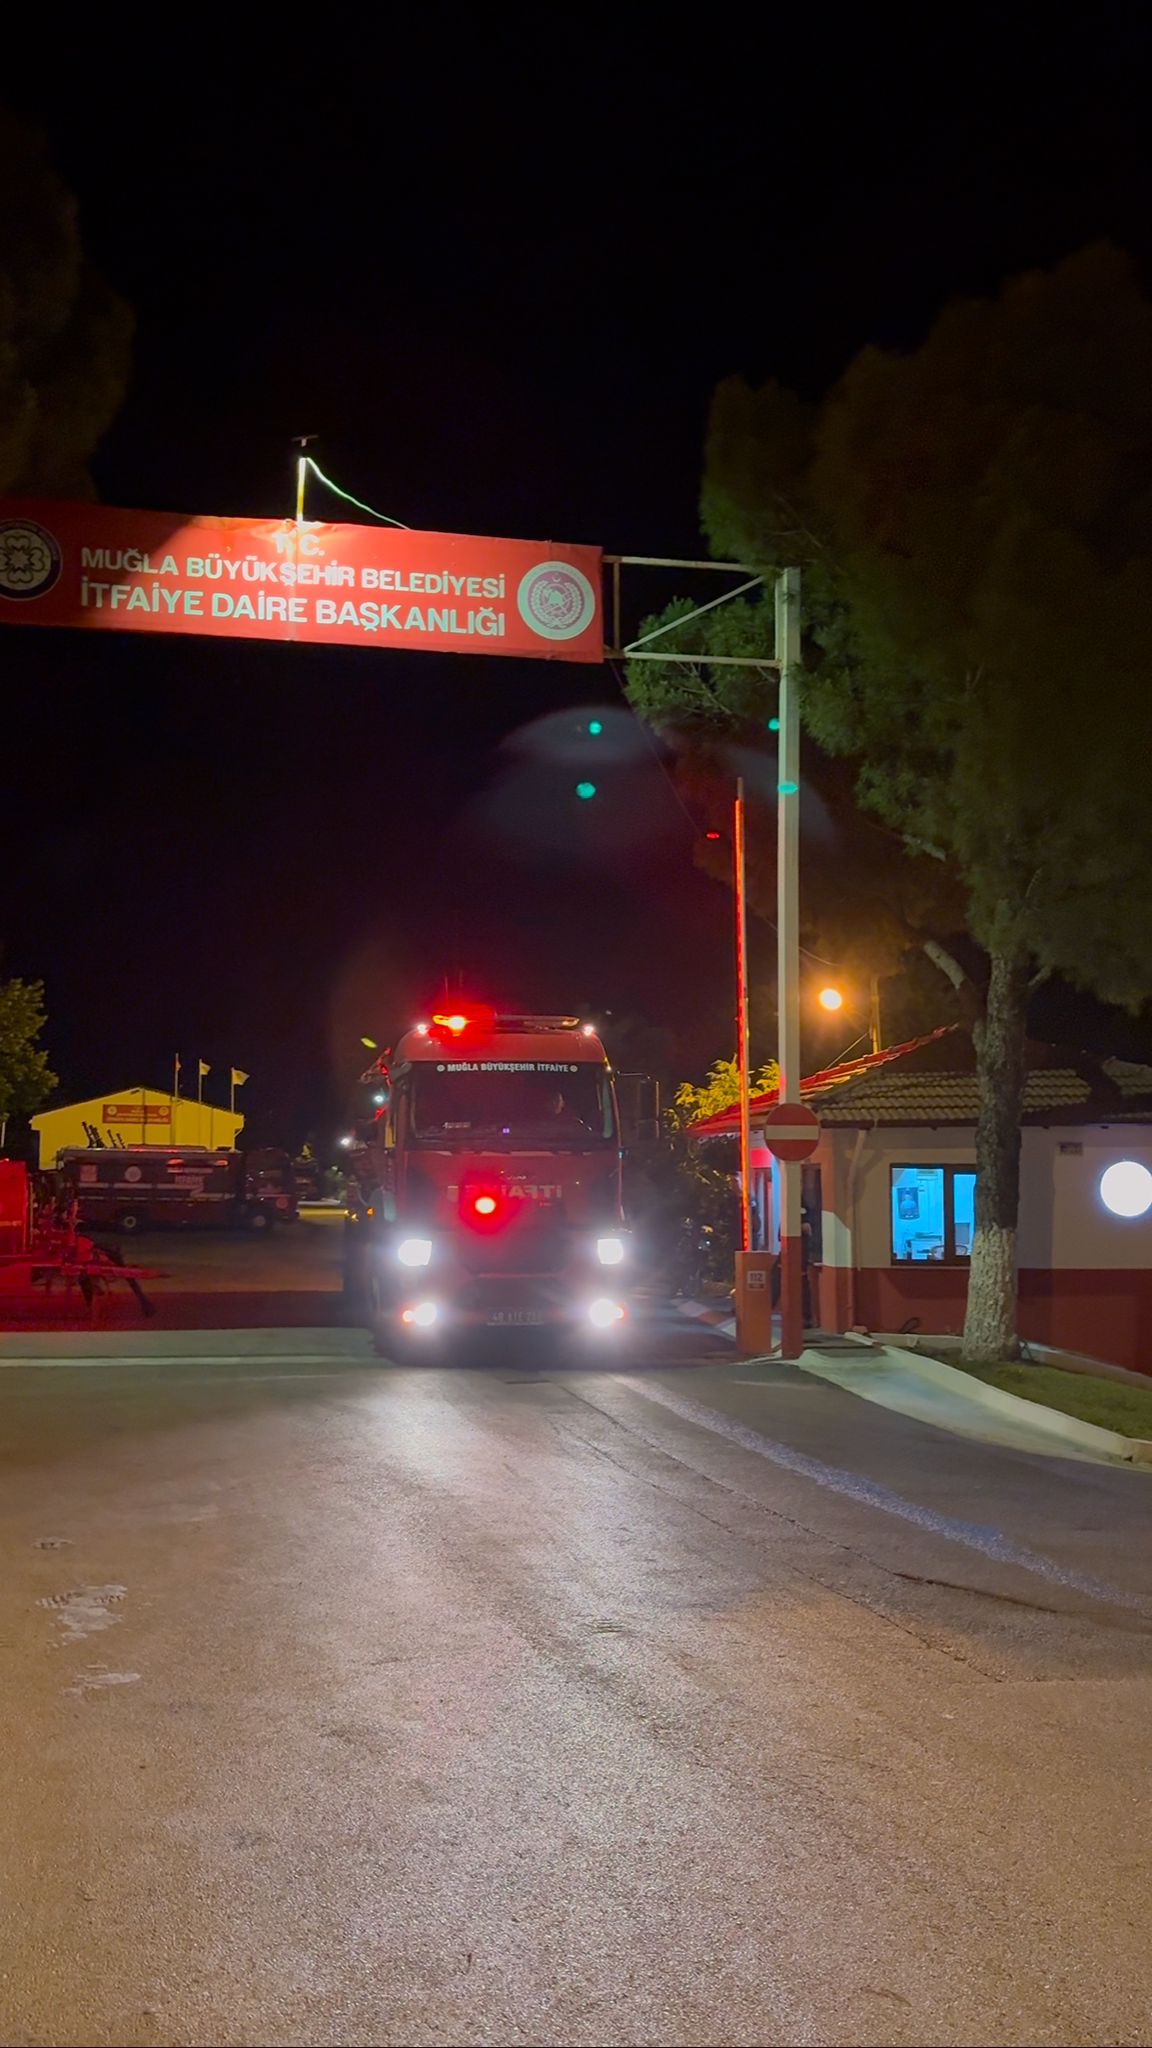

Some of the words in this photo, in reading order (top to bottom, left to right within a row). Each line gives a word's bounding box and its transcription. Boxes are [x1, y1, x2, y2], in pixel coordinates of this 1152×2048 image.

[81, 547, 179, 576] MUĞLA
[186, 553, 355, 587] BÜYÜKŞEHİR
[361, 570, 505, 599] BELEDİYESİ
[80, 577, 204, 616] İTFAİYE
[211, 590, 308, 623] DAİRE
[315, 598, 505, 637] BAŞKANLIĞI
[447, 1062, 479, 1072] MUĞLA
[480, 1062, 535, 1072] BÜYÜKŞEHİR
[537, 1063, 569, 1072] İTFAİYE
